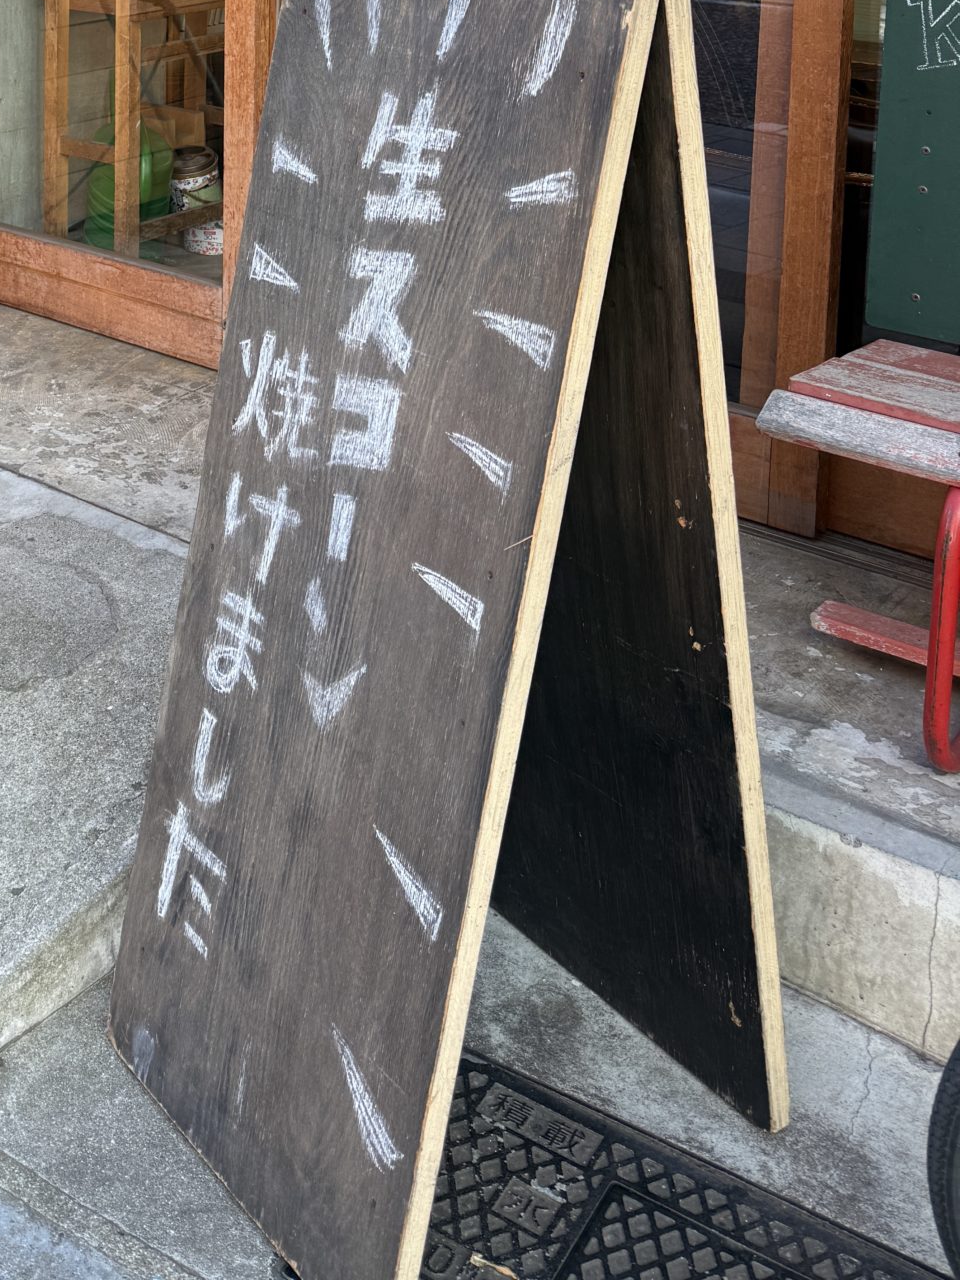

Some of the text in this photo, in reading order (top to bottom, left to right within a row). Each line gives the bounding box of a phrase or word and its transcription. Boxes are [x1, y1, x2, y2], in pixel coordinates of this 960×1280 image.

[157, 330, 320, 960] 焼けました
